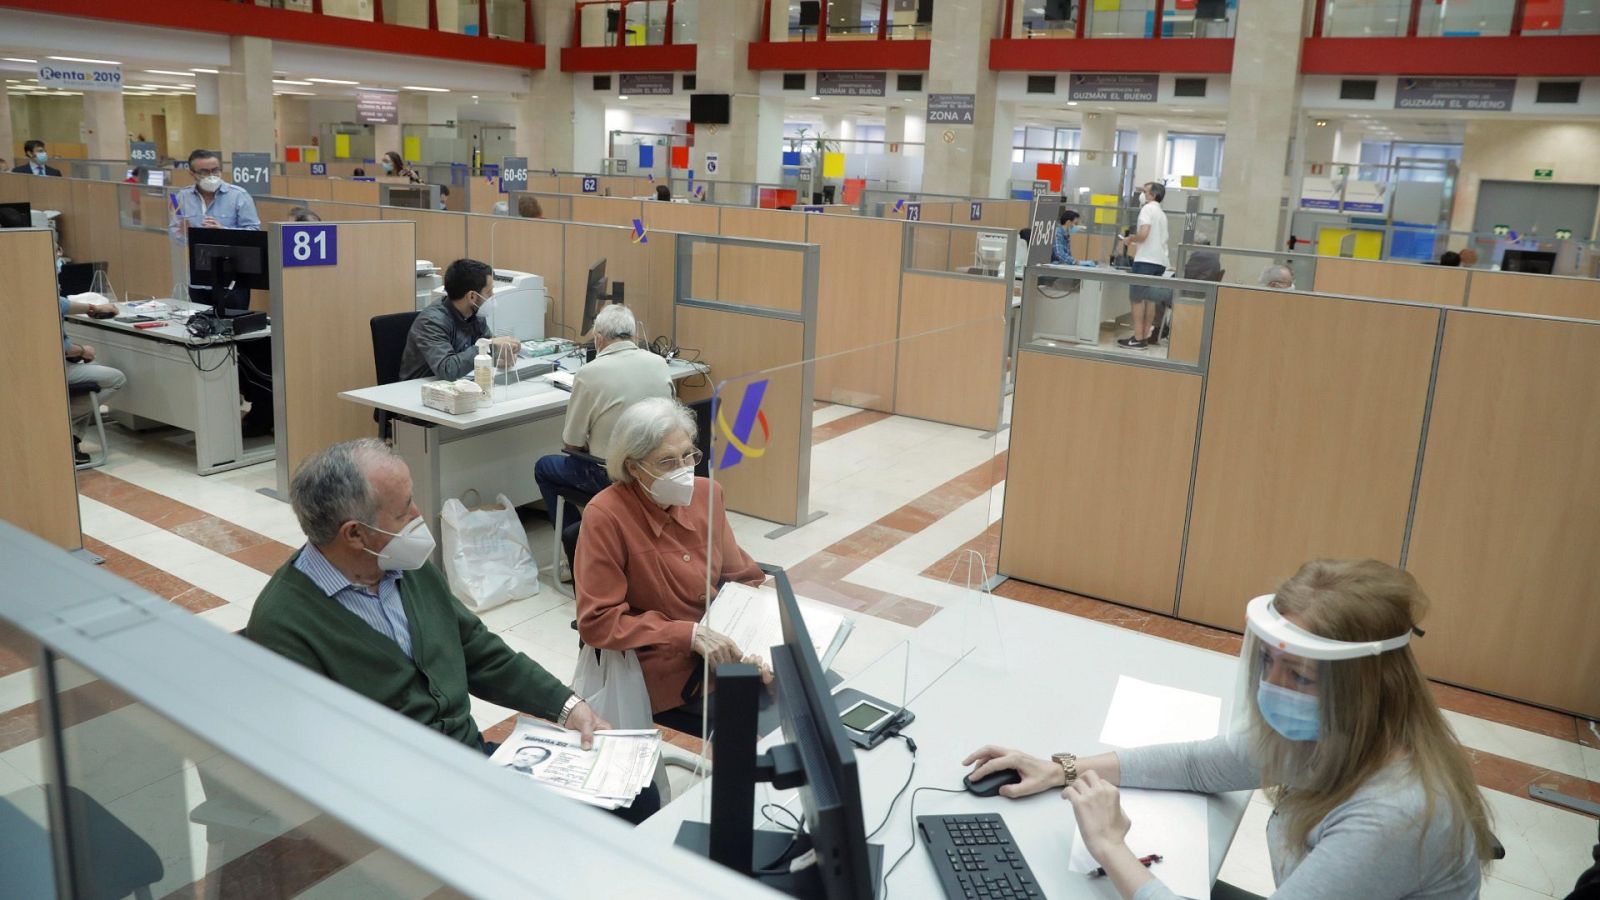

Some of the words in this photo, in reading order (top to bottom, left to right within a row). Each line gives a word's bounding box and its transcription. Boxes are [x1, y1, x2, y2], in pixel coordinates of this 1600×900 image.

[40, 67, 85, 81] Renta
[93, 72, 121, 82] 2019
[1073, 91, 1107, 99] GUZMÁN
[1400, 98, 1445, 107] GUZMÁN
[1449, 100, 1462, 108] EL
[1467, 100, 1505, 109] BUENO
[930, 111, 959, 121] ZONA
[963, 112, 972, 121] A
[131, 150, 156, 160] 48-53
[233, 167, 269, 183] 66-71
[312, 164, 324, 174] 50
[504, 168, 528, 182] 60-65
[584, 179, 596, 190] 62
[909, 206, 919, 220] 73
[972, 204, 980, 218] 74
[1031, 220, 1056, 246] 78-81
[293, 230, 326, 261] 81
